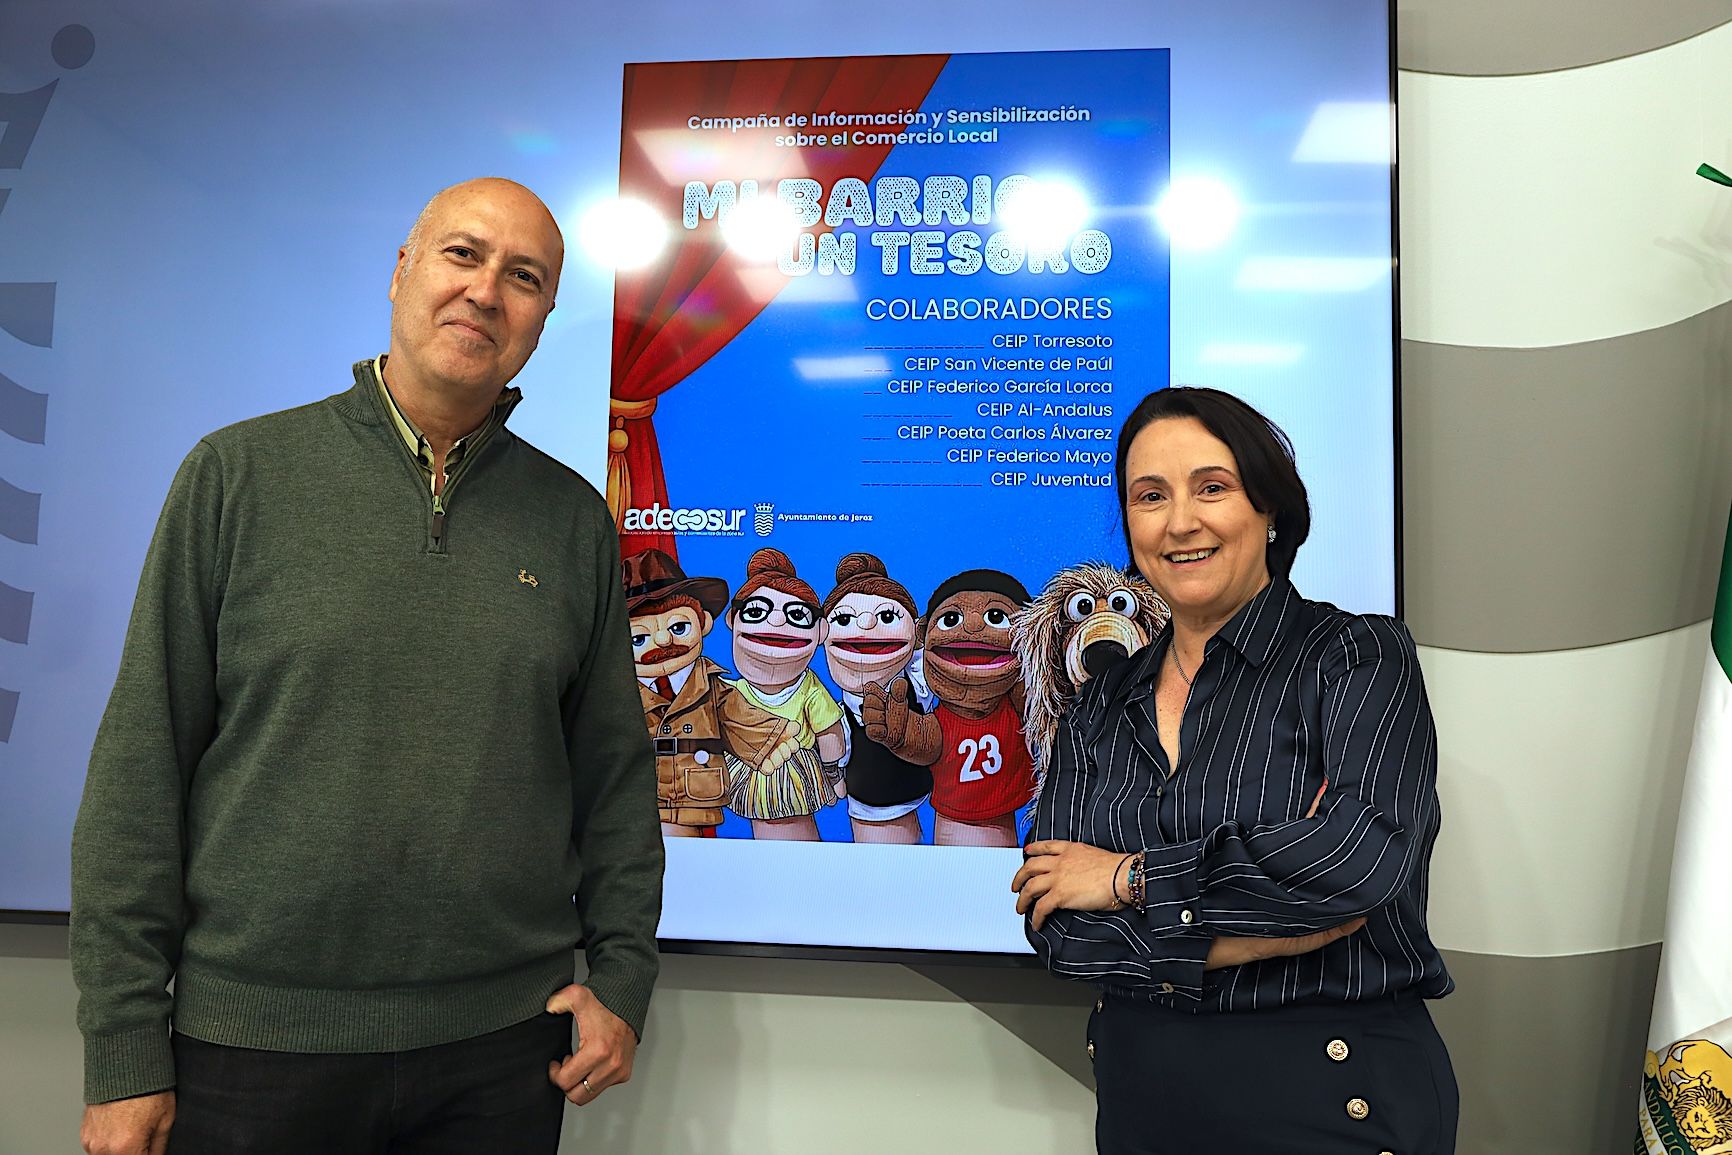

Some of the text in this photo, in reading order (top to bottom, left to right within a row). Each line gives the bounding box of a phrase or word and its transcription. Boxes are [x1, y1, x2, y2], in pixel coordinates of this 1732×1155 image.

[687, 105, 1091, 134] Campaña de Información y Sensibilización
[775, 127, 998, 147] sobre el Comercio Local
[776, 229, 1113, 277] UN TESORO
[865, 297, 1113, 320] COLABORADORES
[991, 334, 1113, 348] CEIP Torresoto
[904, 356, 1113, 371] CEIP San Vicente de Paúl
[887, 380, 1113, 394] CEIP Federico García Lorca
[977, 402, 1113, 417] CEIP Al-Andalus
[897, 423, 1113, 440] CEIP Poeta Carlos Álvarez
[946, 449, 1113, 467] CEIP Federico Mayo
[990, 472, 1112, 487] CEIP Juventud
[623, 502, 747, 531] adecosur
[957, 733, 1003, 783] 23
[1639, 1108, 1658, 1150] PARA
